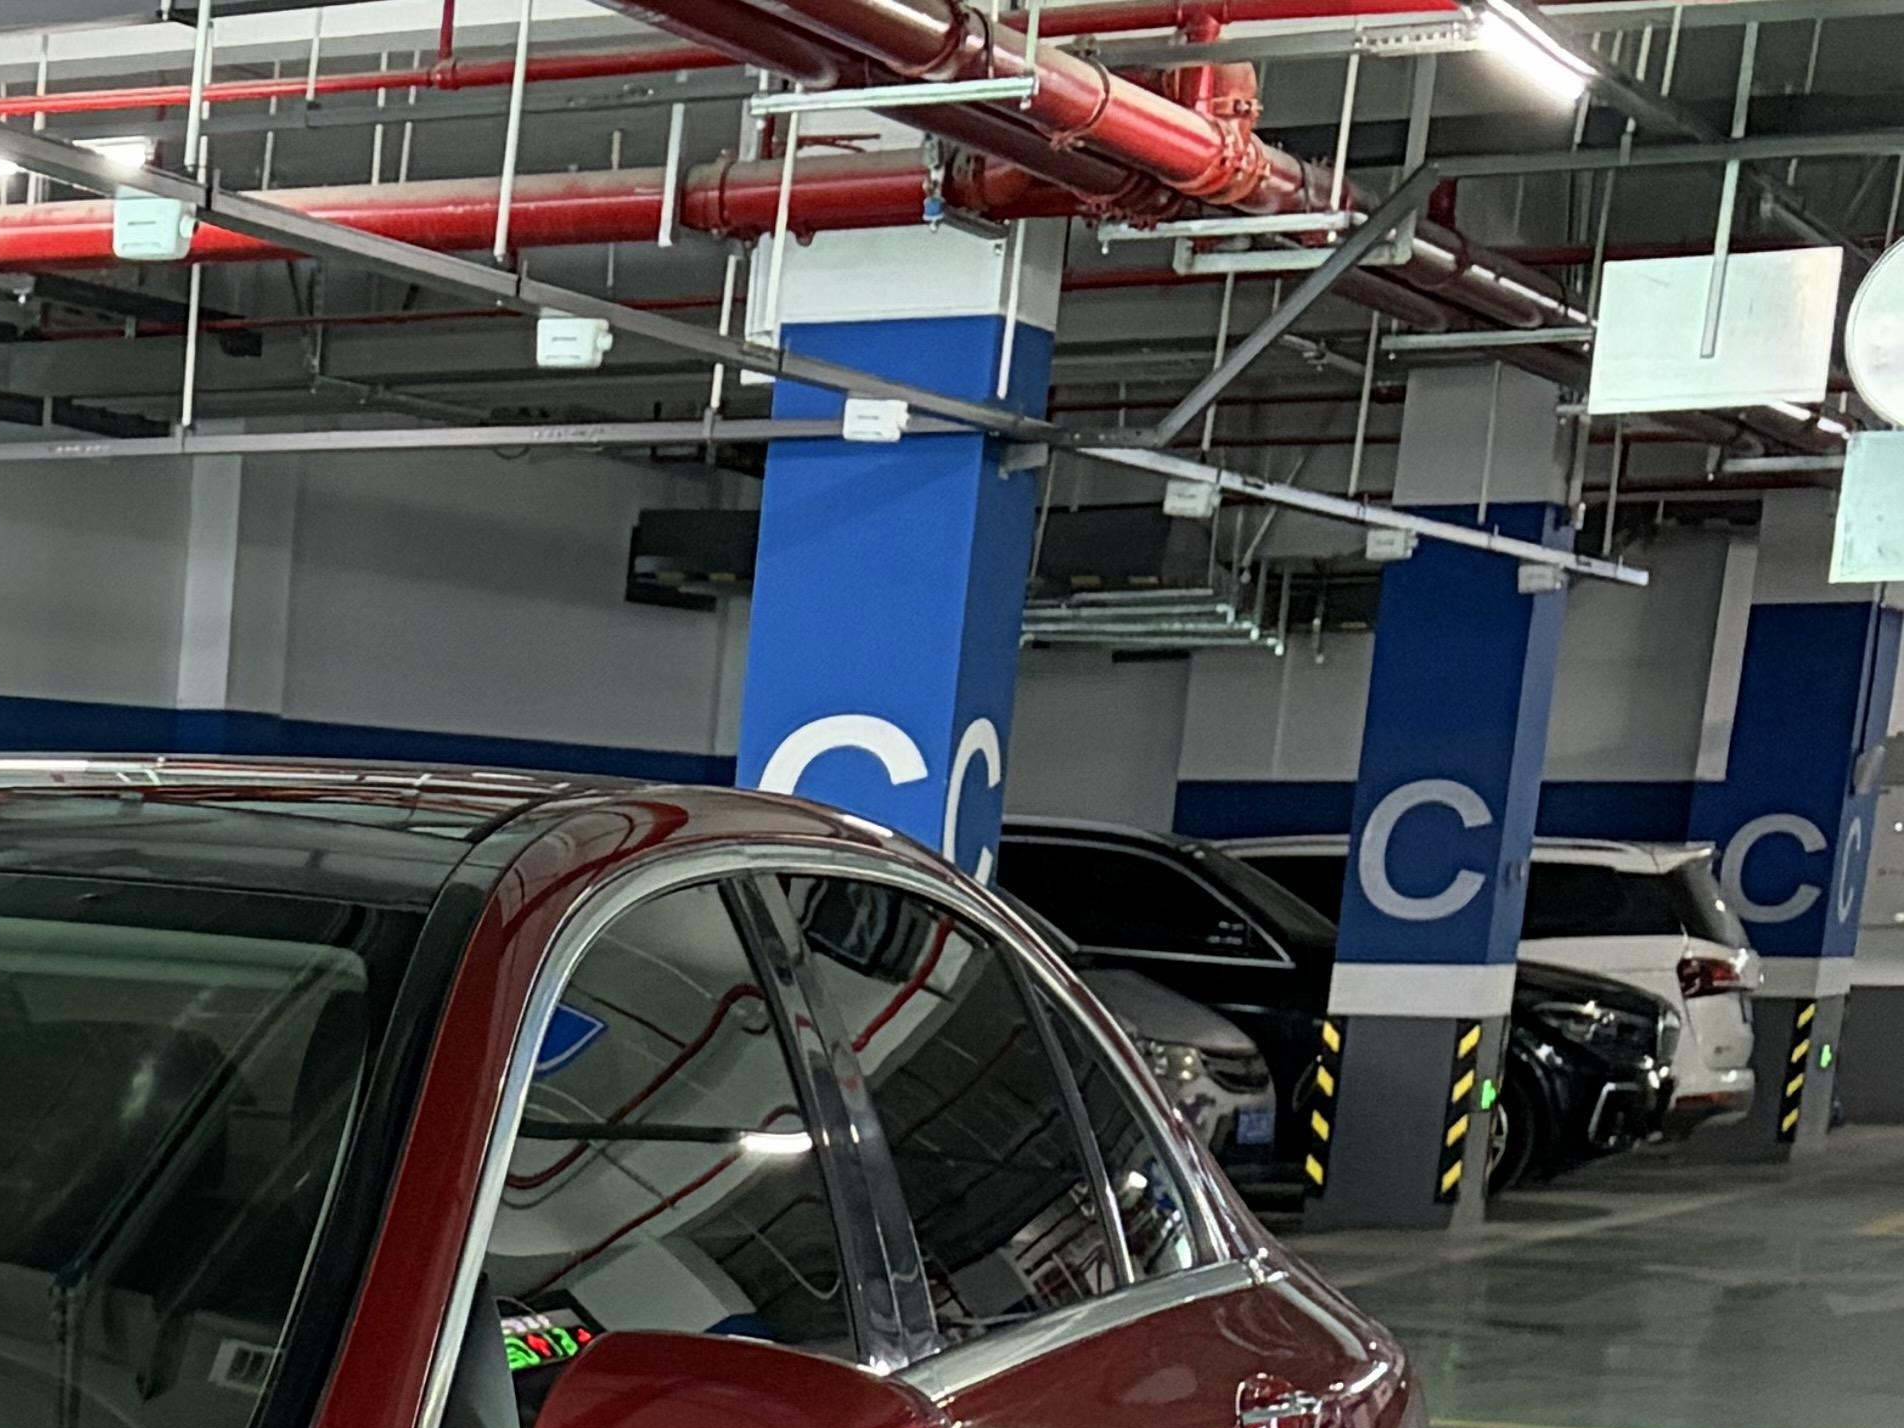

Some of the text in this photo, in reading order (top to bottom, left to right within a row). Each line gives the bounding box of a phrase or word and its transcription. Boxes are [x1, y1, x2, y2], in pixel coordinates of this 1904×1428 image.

[1358, 779, 1494, 922] C
[1722, 813, 1828, 923] C
[1837, 816, 1862, 923] C
